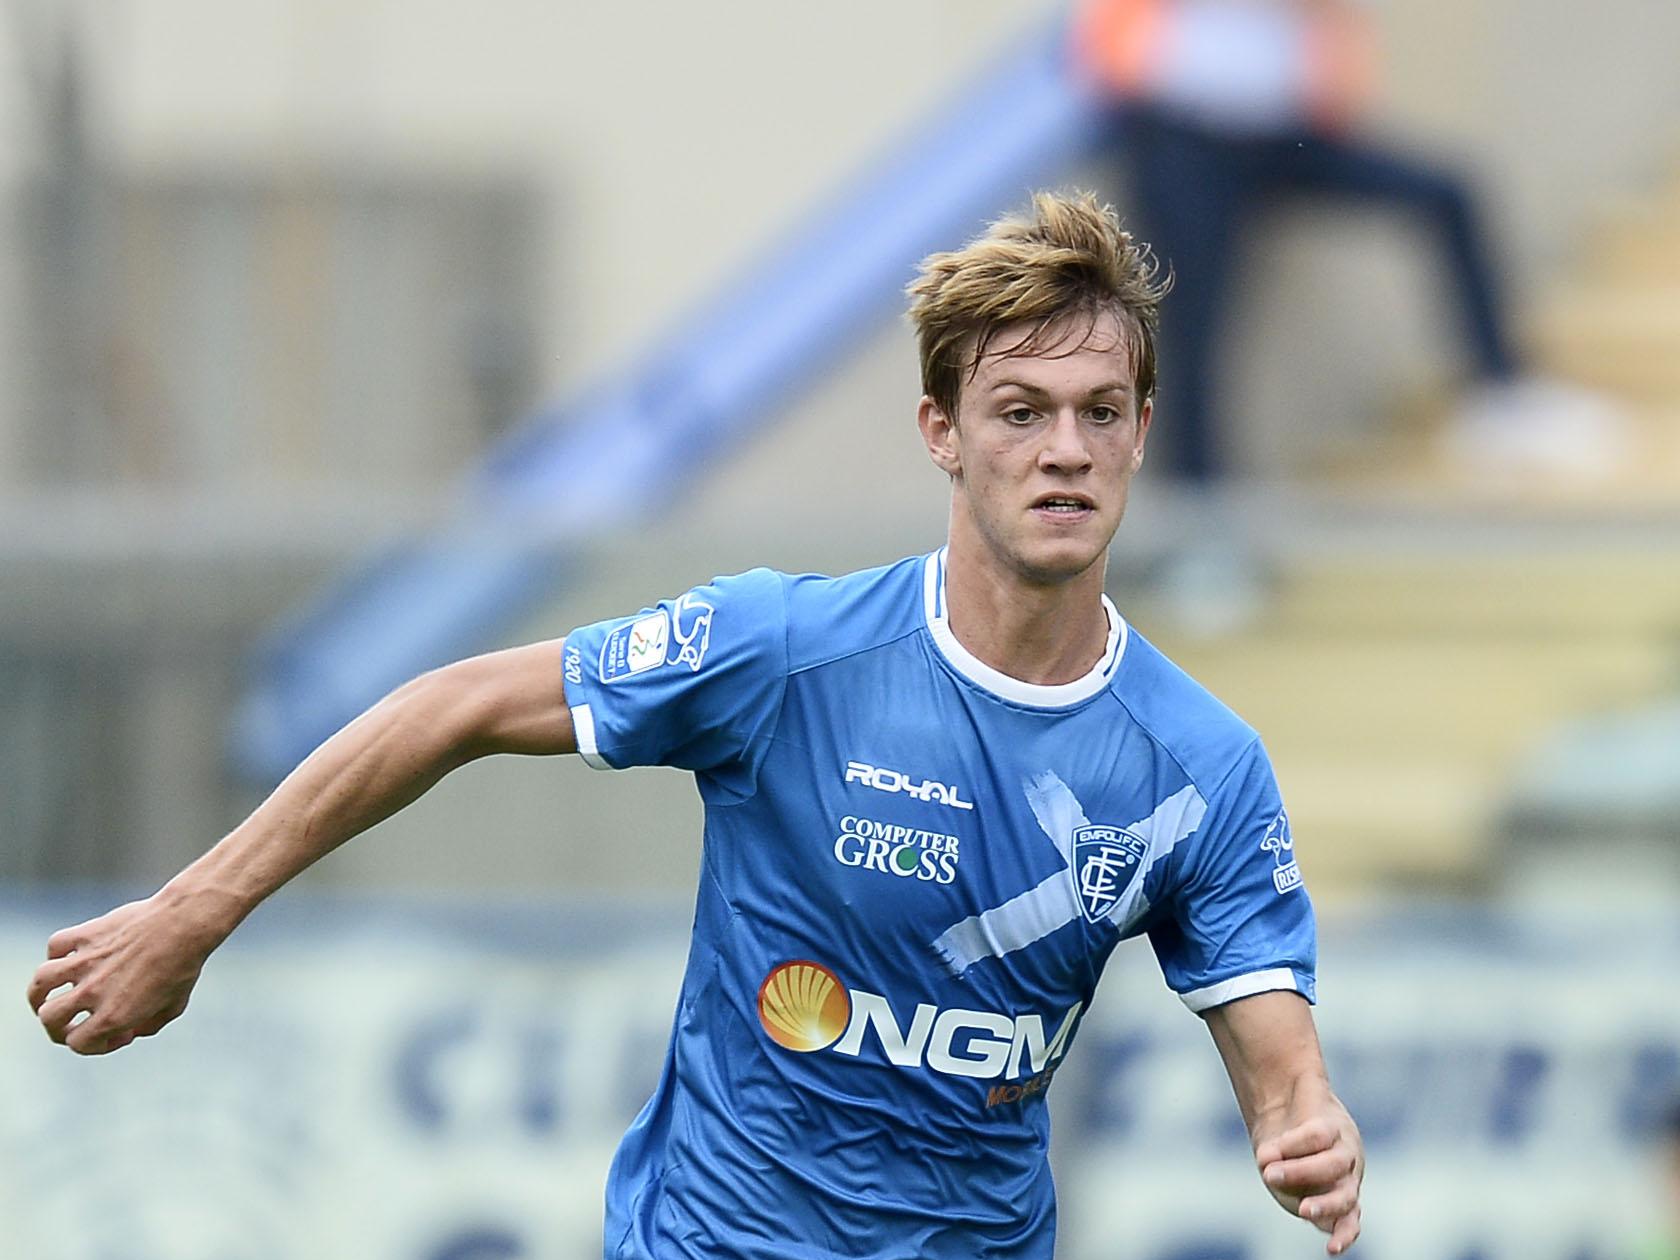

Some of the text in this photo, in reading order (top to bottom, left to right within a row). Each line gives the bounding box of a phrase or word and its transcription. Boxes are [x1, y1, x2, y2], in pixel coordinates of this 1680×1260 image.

[564, 645, 583, 685] 1920
[845, 761, 974, 810] ROYAL
[840, 815, 960, 854] COMPUTER
[1079, 829, 1123, 843] EMPOLI
[834, 833, 959, 884] GROSS
[833, 989, 1083, 1080] NGM
